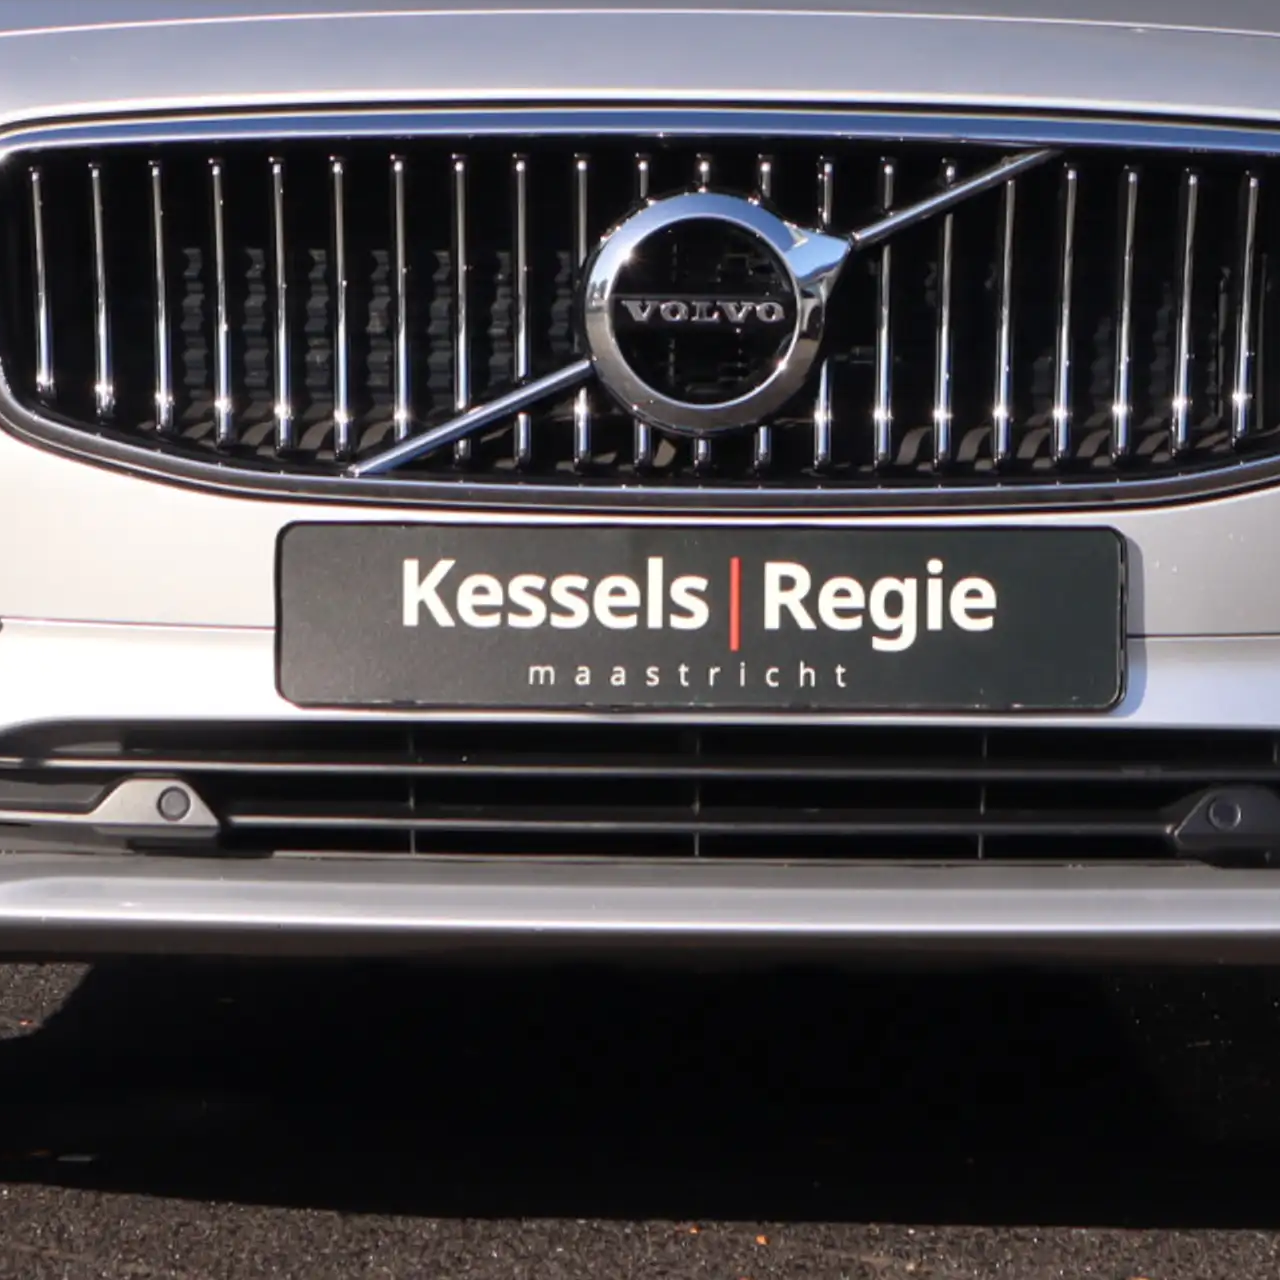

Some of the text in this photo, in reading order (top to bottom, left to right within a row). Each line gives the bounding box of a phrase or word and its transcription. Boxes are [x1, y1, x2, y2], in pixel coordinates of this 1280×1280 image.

[622, 300, 786, 322] VOLVO
[401, 556, 998, 653] Kessels Regie
[527, 659, 848, 688] maastricht
